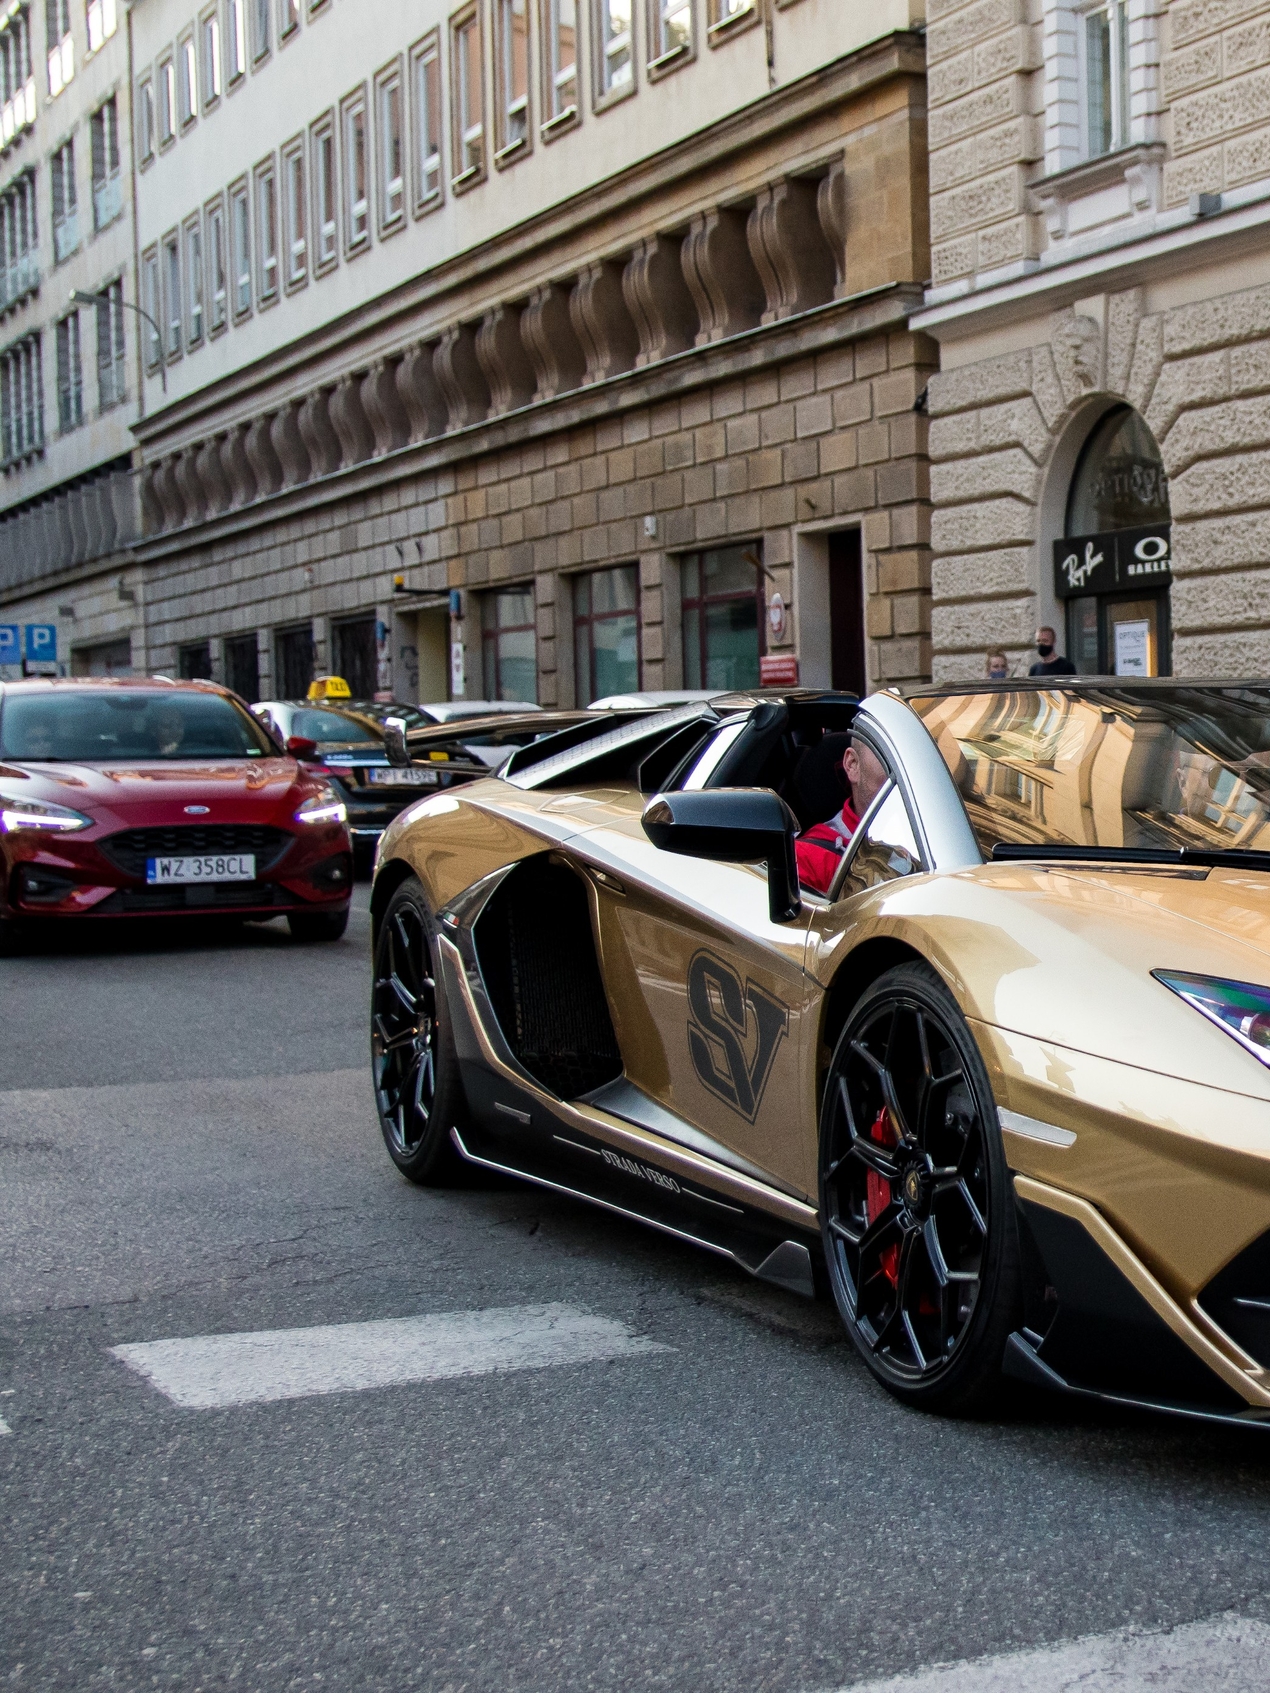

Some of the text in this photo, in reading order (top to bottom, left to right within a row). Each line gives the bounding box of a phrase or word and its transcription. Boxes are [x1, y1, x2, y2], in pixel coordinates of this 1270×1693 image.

[32, 627, 51, 650] P
[159, 857, 249, 877] WZ 358CL
[601, 1148, 681, 1193] STRADA VERSO
